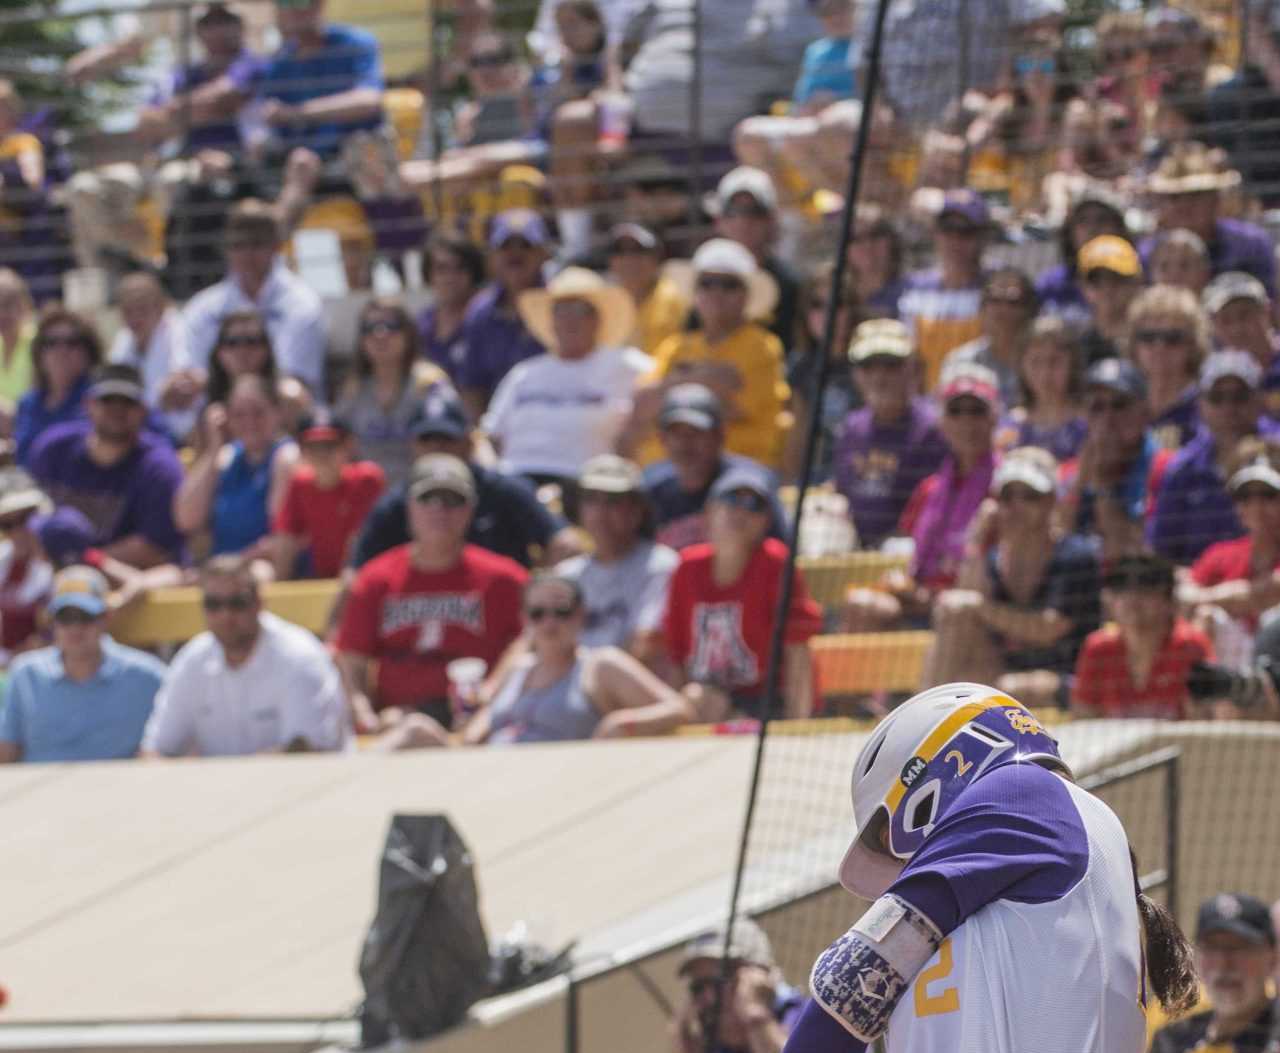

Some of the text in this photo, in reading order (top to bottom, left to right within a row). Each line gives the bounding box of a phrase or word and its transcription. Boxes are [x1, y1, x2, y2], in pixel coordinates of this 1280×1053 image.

[902, 758, 927, 787] MM
[944, 750, 973, 777] 2
[914, 936, 960, 1018] 2
